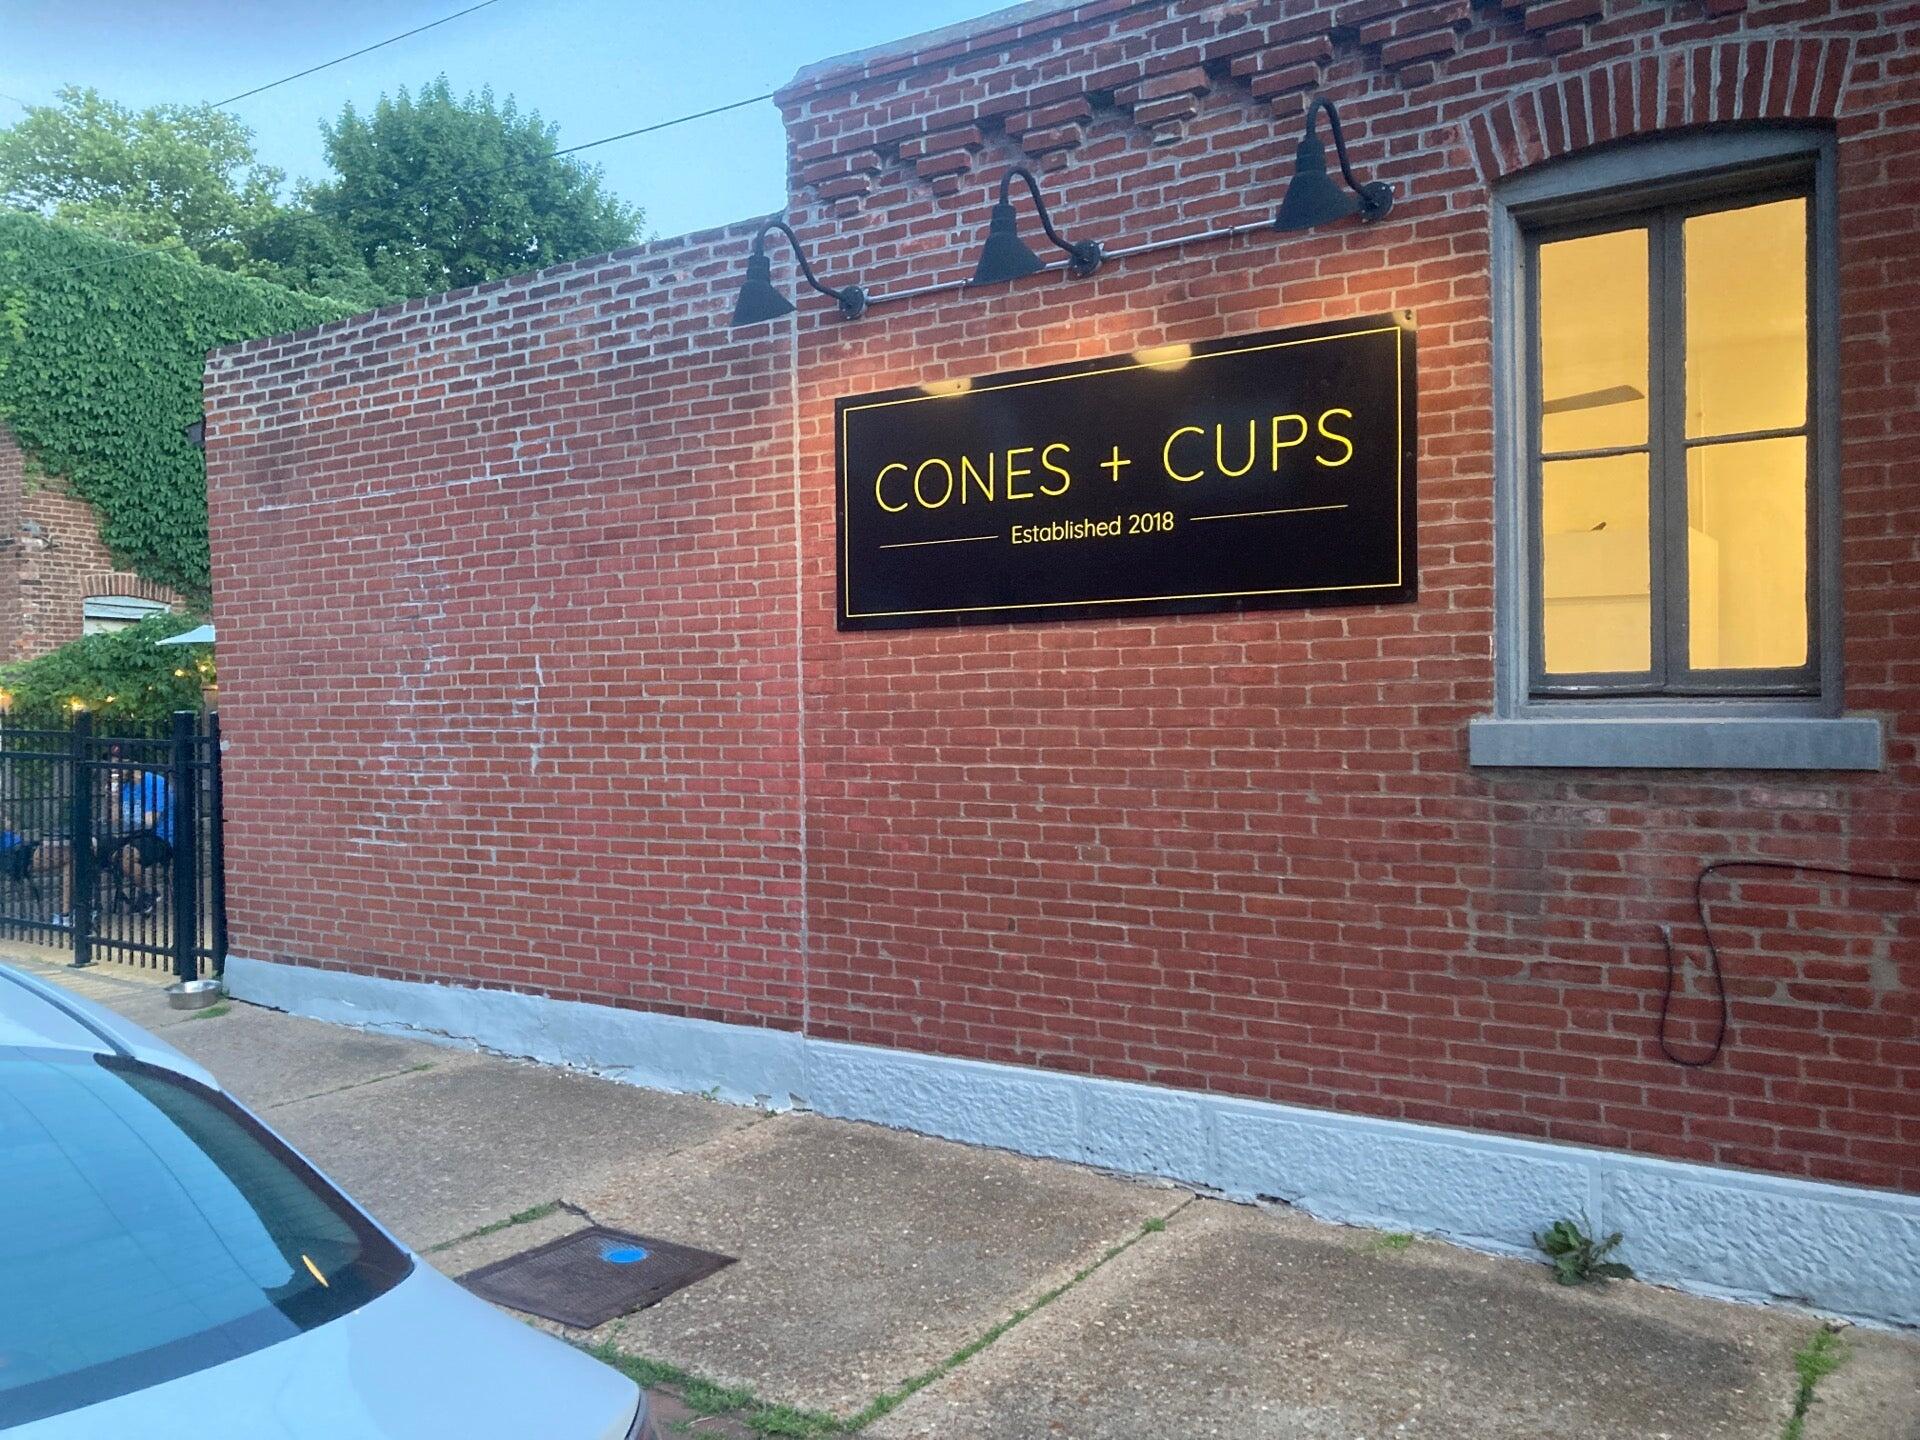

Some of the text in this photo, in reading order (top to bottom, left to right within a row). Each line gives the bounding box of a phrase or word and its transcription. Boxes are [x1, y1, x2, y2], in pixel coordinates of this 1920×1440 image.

[875, 407, 1354, 513] CONES + CUPS
[1010, 511, 1175, 545] Established 2018
